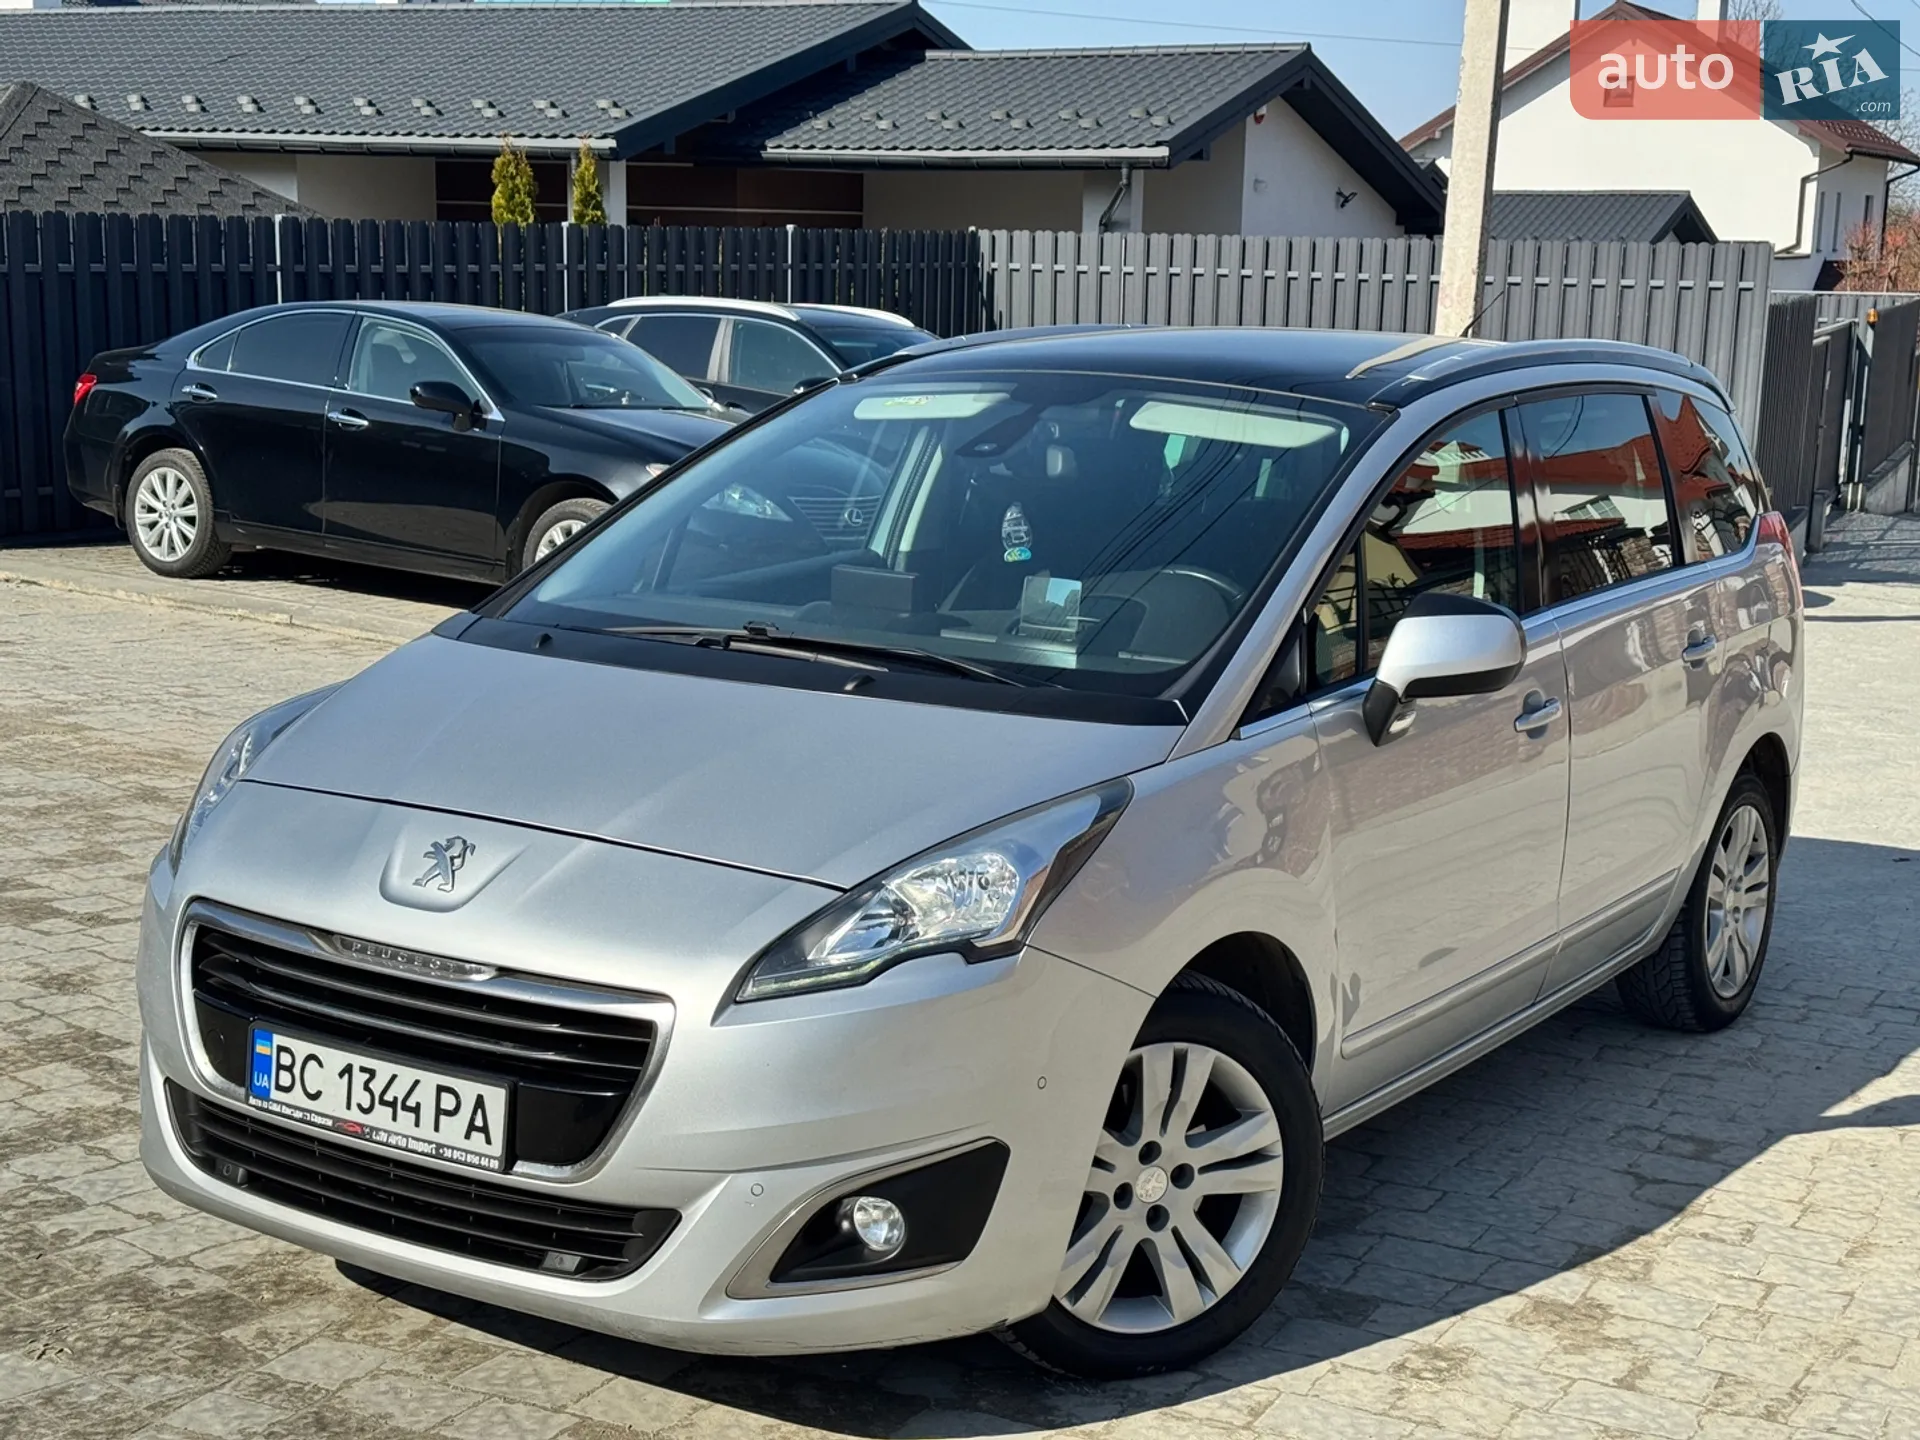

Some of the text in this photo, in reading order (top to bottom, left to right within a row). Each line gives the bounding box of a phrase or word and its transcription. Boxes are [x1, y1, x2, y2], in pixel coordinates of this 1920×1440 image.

[254, 1071, 269, 1089] UA
[275, 1044, 492, 1145] BC 1344 PA
[408, 1137, 437, 1154] Import
